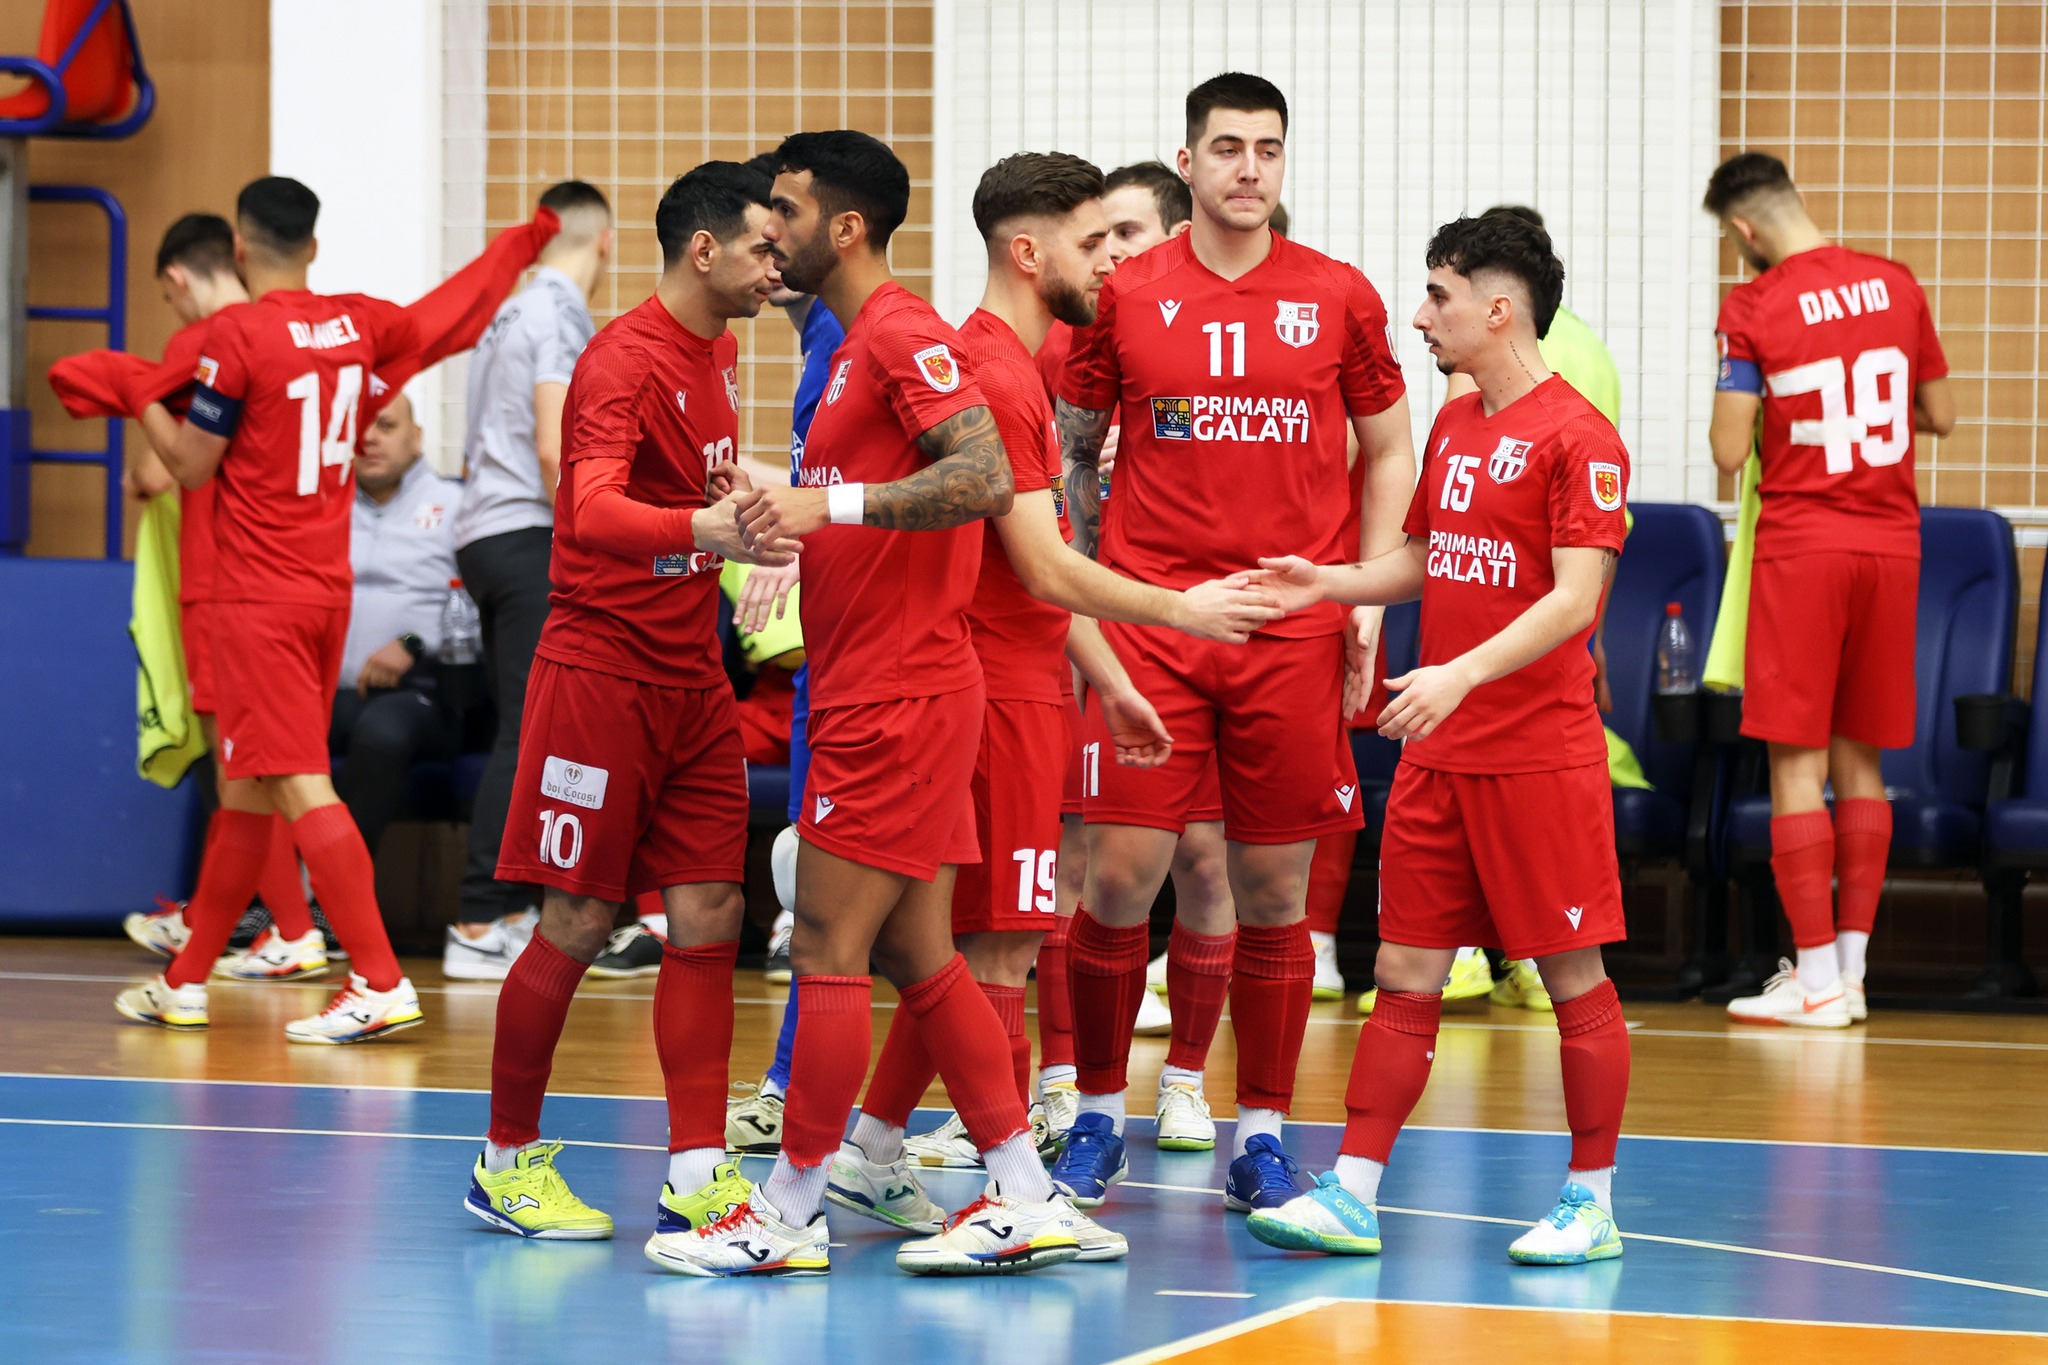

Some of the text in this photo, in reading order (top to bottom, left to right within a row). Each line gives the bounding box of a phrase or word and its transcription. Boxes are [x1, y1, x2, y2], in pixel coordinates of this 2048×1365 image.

[1799, 278, 1891, 326] DAVID
[1202, 321, 1246, 377] 11
[286, 363, 364, 497] 14
[1440, 454, 1483, 513] 15
[539, 809, 583, 869] 10
[1012, 848, 1057, 913] 19
